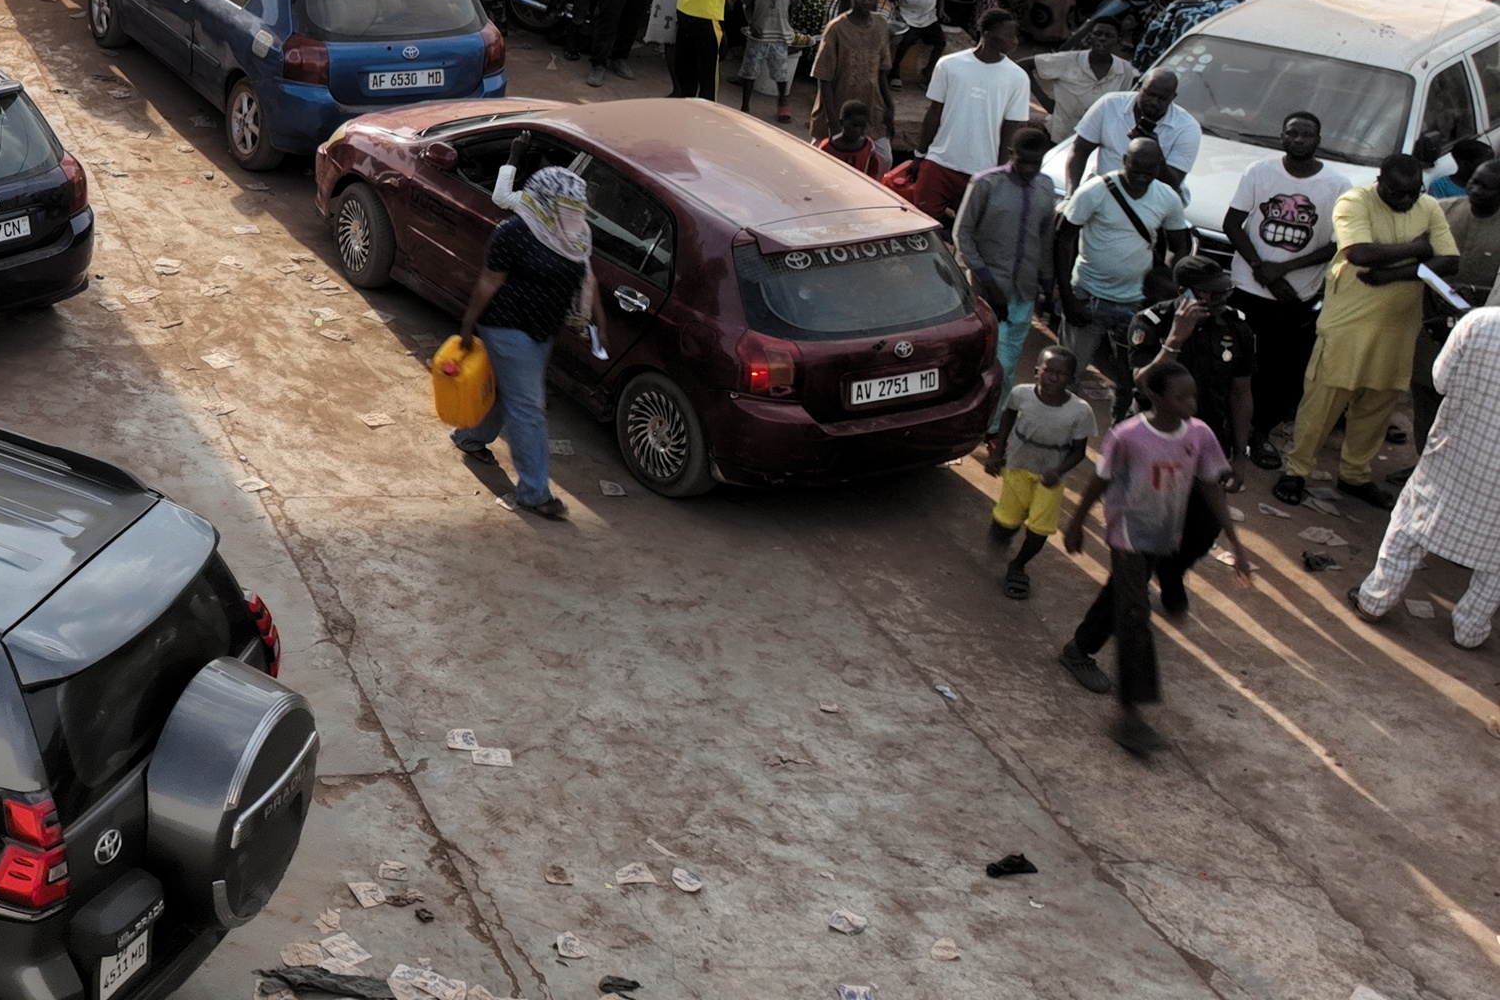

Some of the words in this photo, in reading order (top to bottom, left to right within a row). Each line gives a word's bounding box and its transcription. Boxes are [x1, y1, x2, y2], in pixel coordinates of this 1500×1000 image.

[372, 74, 386, 88] AF
[390, 72, 417, 87] 6530
[428, 71, 441, 84] MD
[815, 239, 906, 265] TOYOTA
[856, 382, 872, 401] AV
[878, 376, 909, 397] 2751
[920, 371, 936, 390] MD
[264, 764, 306, 820] PRADO
[103, 958, 128, 989] 4511
[131, 942, 145, 965] MD
